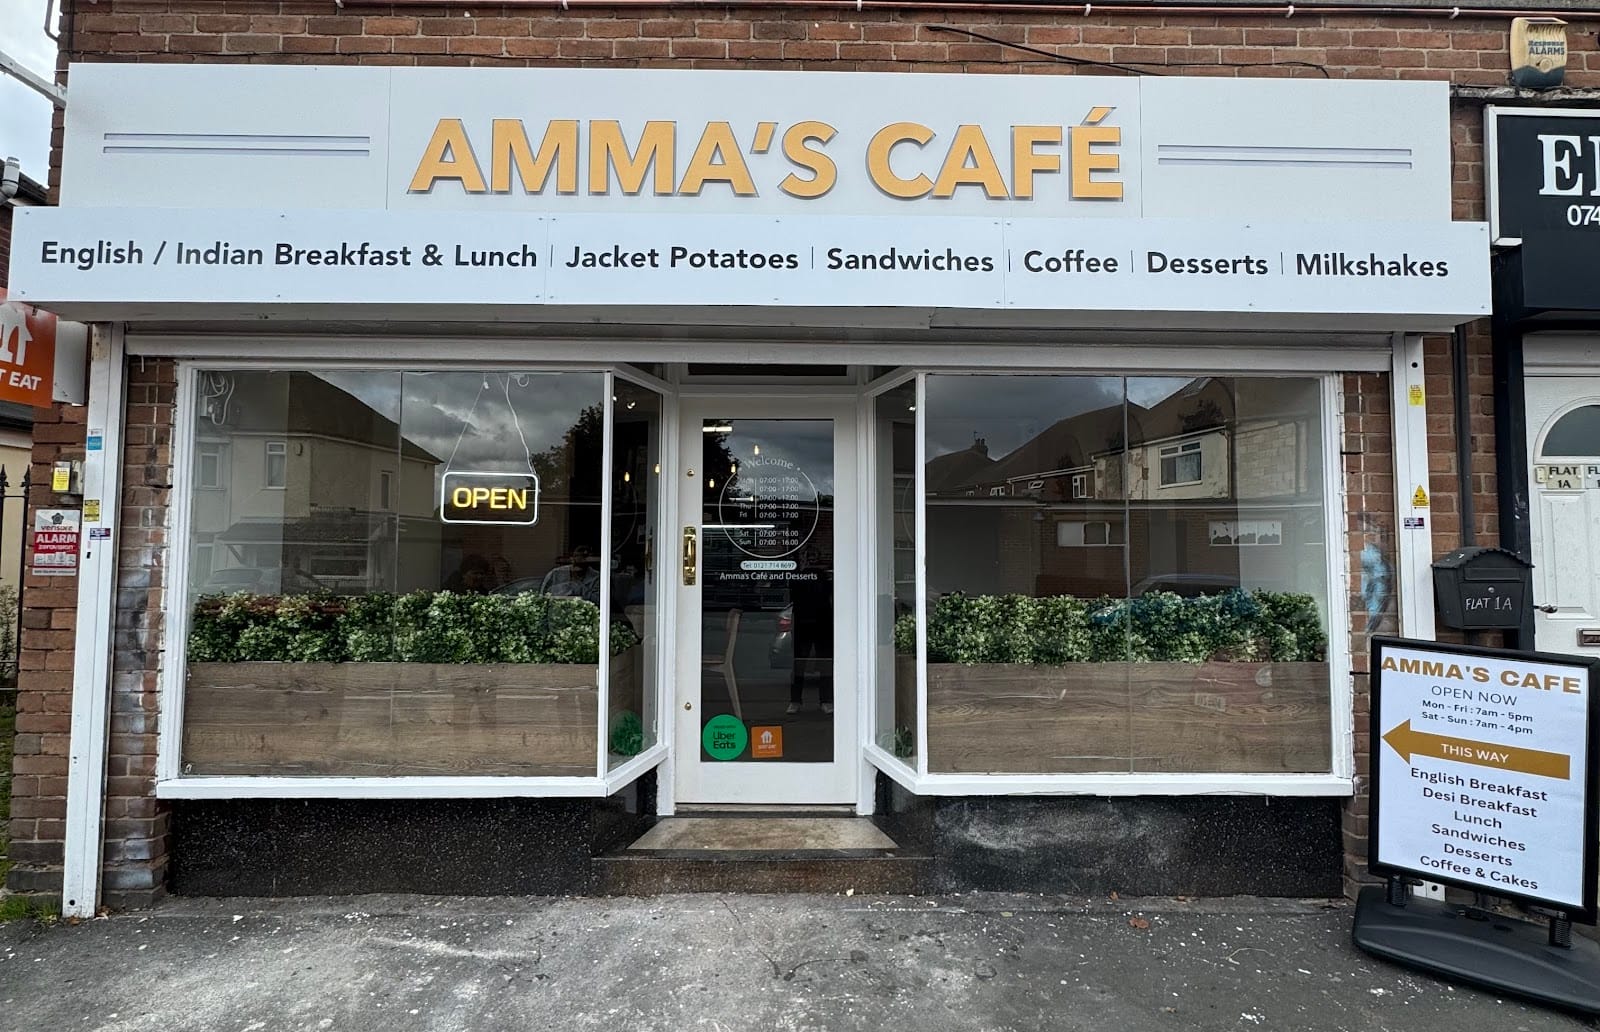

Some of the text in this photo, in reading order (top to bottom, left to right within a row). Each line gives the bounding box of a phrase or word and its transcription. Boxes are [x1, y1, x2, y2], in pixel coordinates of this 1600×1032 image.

[1528, 47, 1565, 55] ALARMS
[408, 106, 1124, 202] AMMA'S CAFÉ
[40, 240, 1449, 278] English / Indian Breakfast & Lunch Jacket Potatoes Sandwiches Coffee Desserts Milkshakes
[9, 371, 42, 390] EAT
[743, 455, 794, 469] Welcome
[1549, 466, 1577, 475] FLAT
[1558, 480, 1571, 488] 1A
[453, 486, 527, 510] OPEN
[36, 533, 77, 543] ALARM
[719, 571, 818, 580] Amma's Café and Desserts
[1465, 597, 1491, 611] FLAT
[1381, 656, 1581, 695] AMMA'S CAFE
[1431, 685, 1518, 706] OPEN NOW
[1422, 699, 1445, 710] Mon
[1454, 703, 1468, 714] Fri
[1476, 707, 1499, 718] 7am
[1508, 711, 1533, 723] 5pm
[1421, 710, 1439, 721] Sat
[1447, 715, 1468, 726] Sun
[1476, 718, 1499, 730] 7am
[1507, 723, 1533, 735] 4pm
[713, 731, 736, 740] Uber
[713, 741, 736, 749] Eats
[1441, 743, 1510, 764] THIS WAY
[1411, 767, 1548, 802] English Breakfast
[1423, 787, 1538, 818] Desi Breakfast
[1454, 810, 1502, 829] Lunch
[1431, 823, 1526, 852] Sandwiches
[1444, 843, 1513, 867] Desserts
[1420, 855, 1538, 891] Coffee & Cakes
